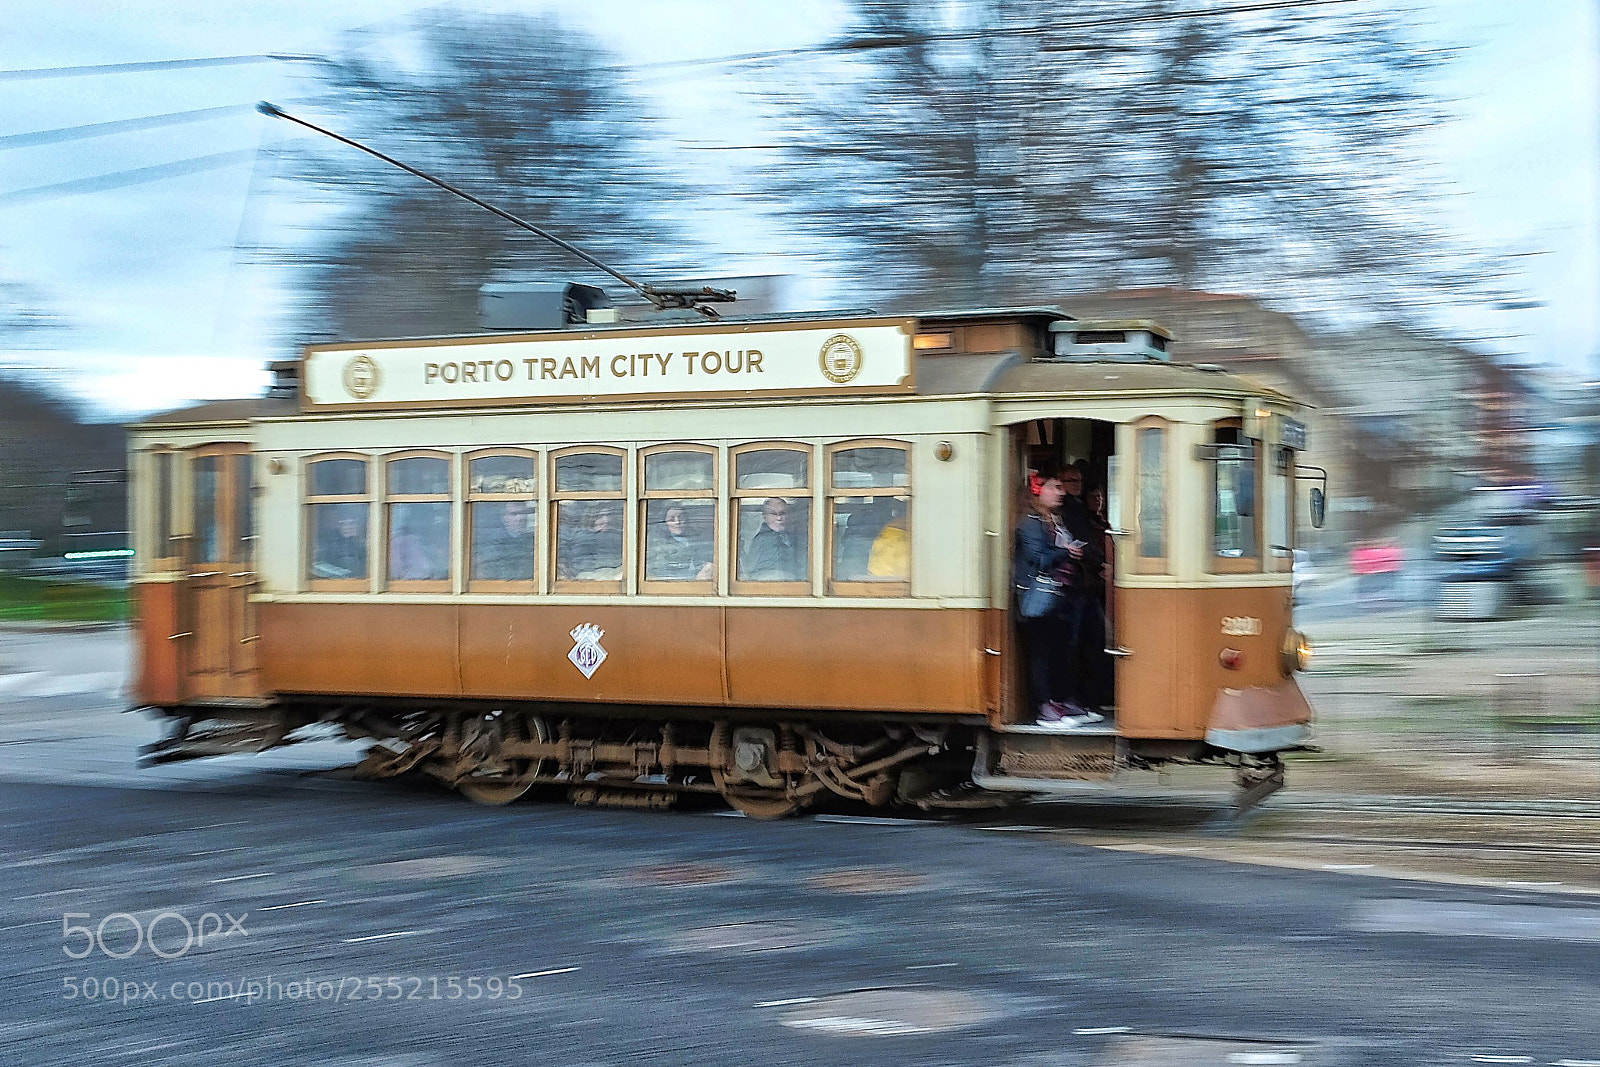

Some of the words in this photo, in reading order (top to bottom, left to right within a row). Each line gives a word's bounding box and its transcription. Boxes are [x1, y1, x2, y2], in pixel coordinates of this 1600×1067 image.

[424, 358, 515, 385] PORTO
[522, 355, 601, 381] TRAM
[610, 352, 674, 378] CITY
[681, 349, 765, 375] TOUR
